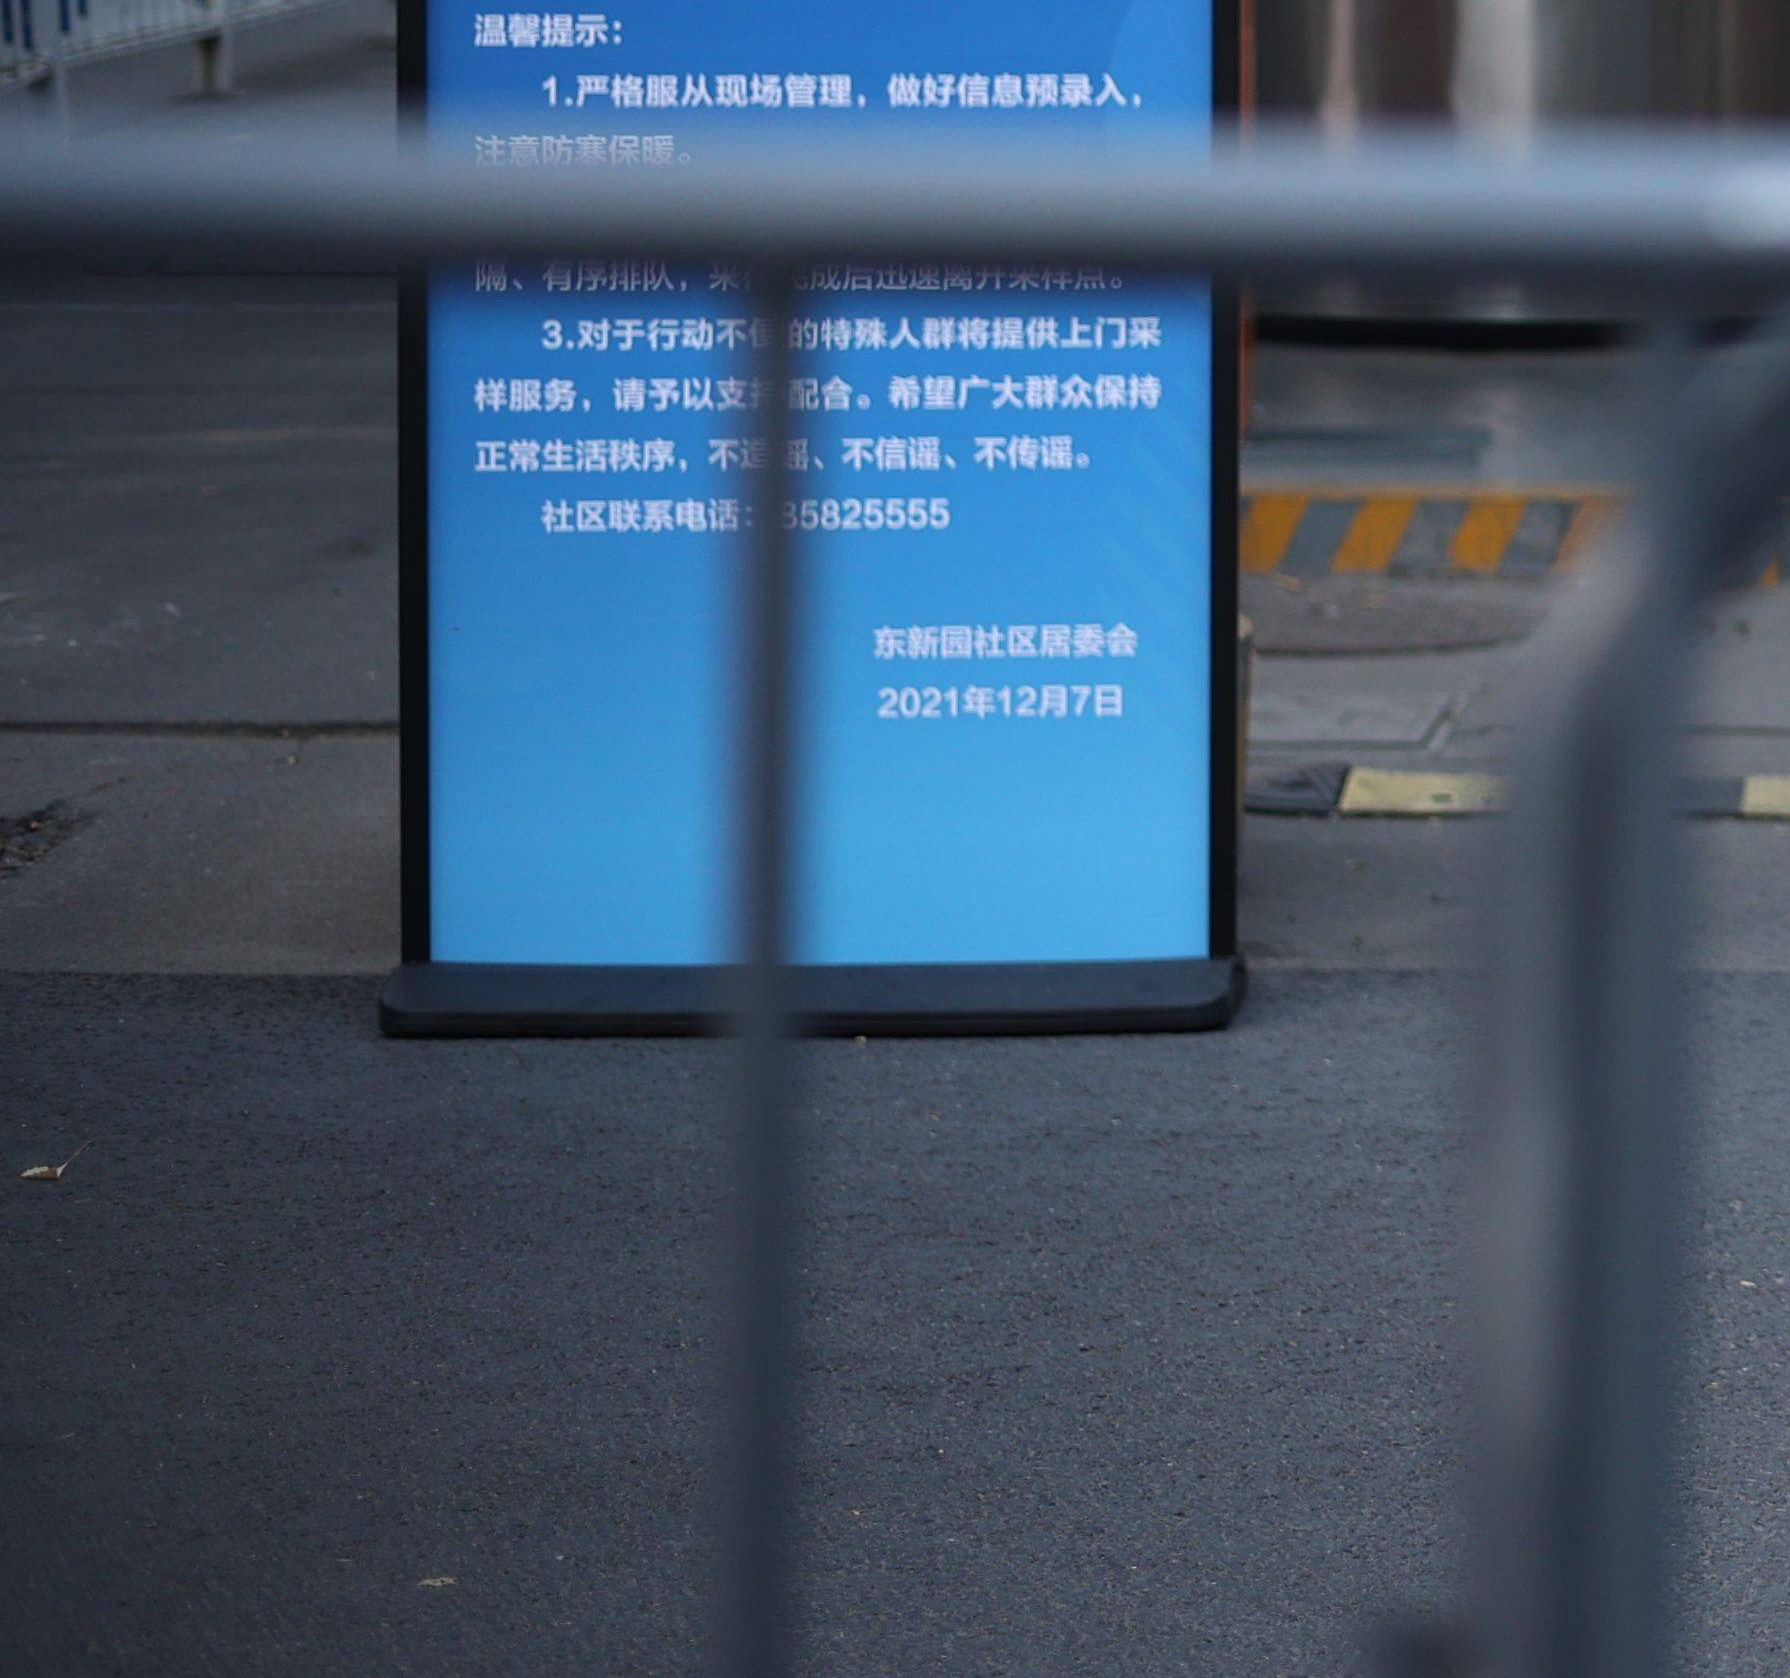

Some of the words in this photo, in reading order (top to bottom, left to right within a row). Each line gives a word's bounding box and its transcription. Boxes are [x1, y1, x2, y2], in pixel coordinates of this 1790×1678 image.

[542, 73, 1143, 111] 1.严格服从现场管理，做好信息预录入，
[873, 622, 1139, 660] 东新园社区居委会
[877, 684, 1124, 720] 2021年12月7日
